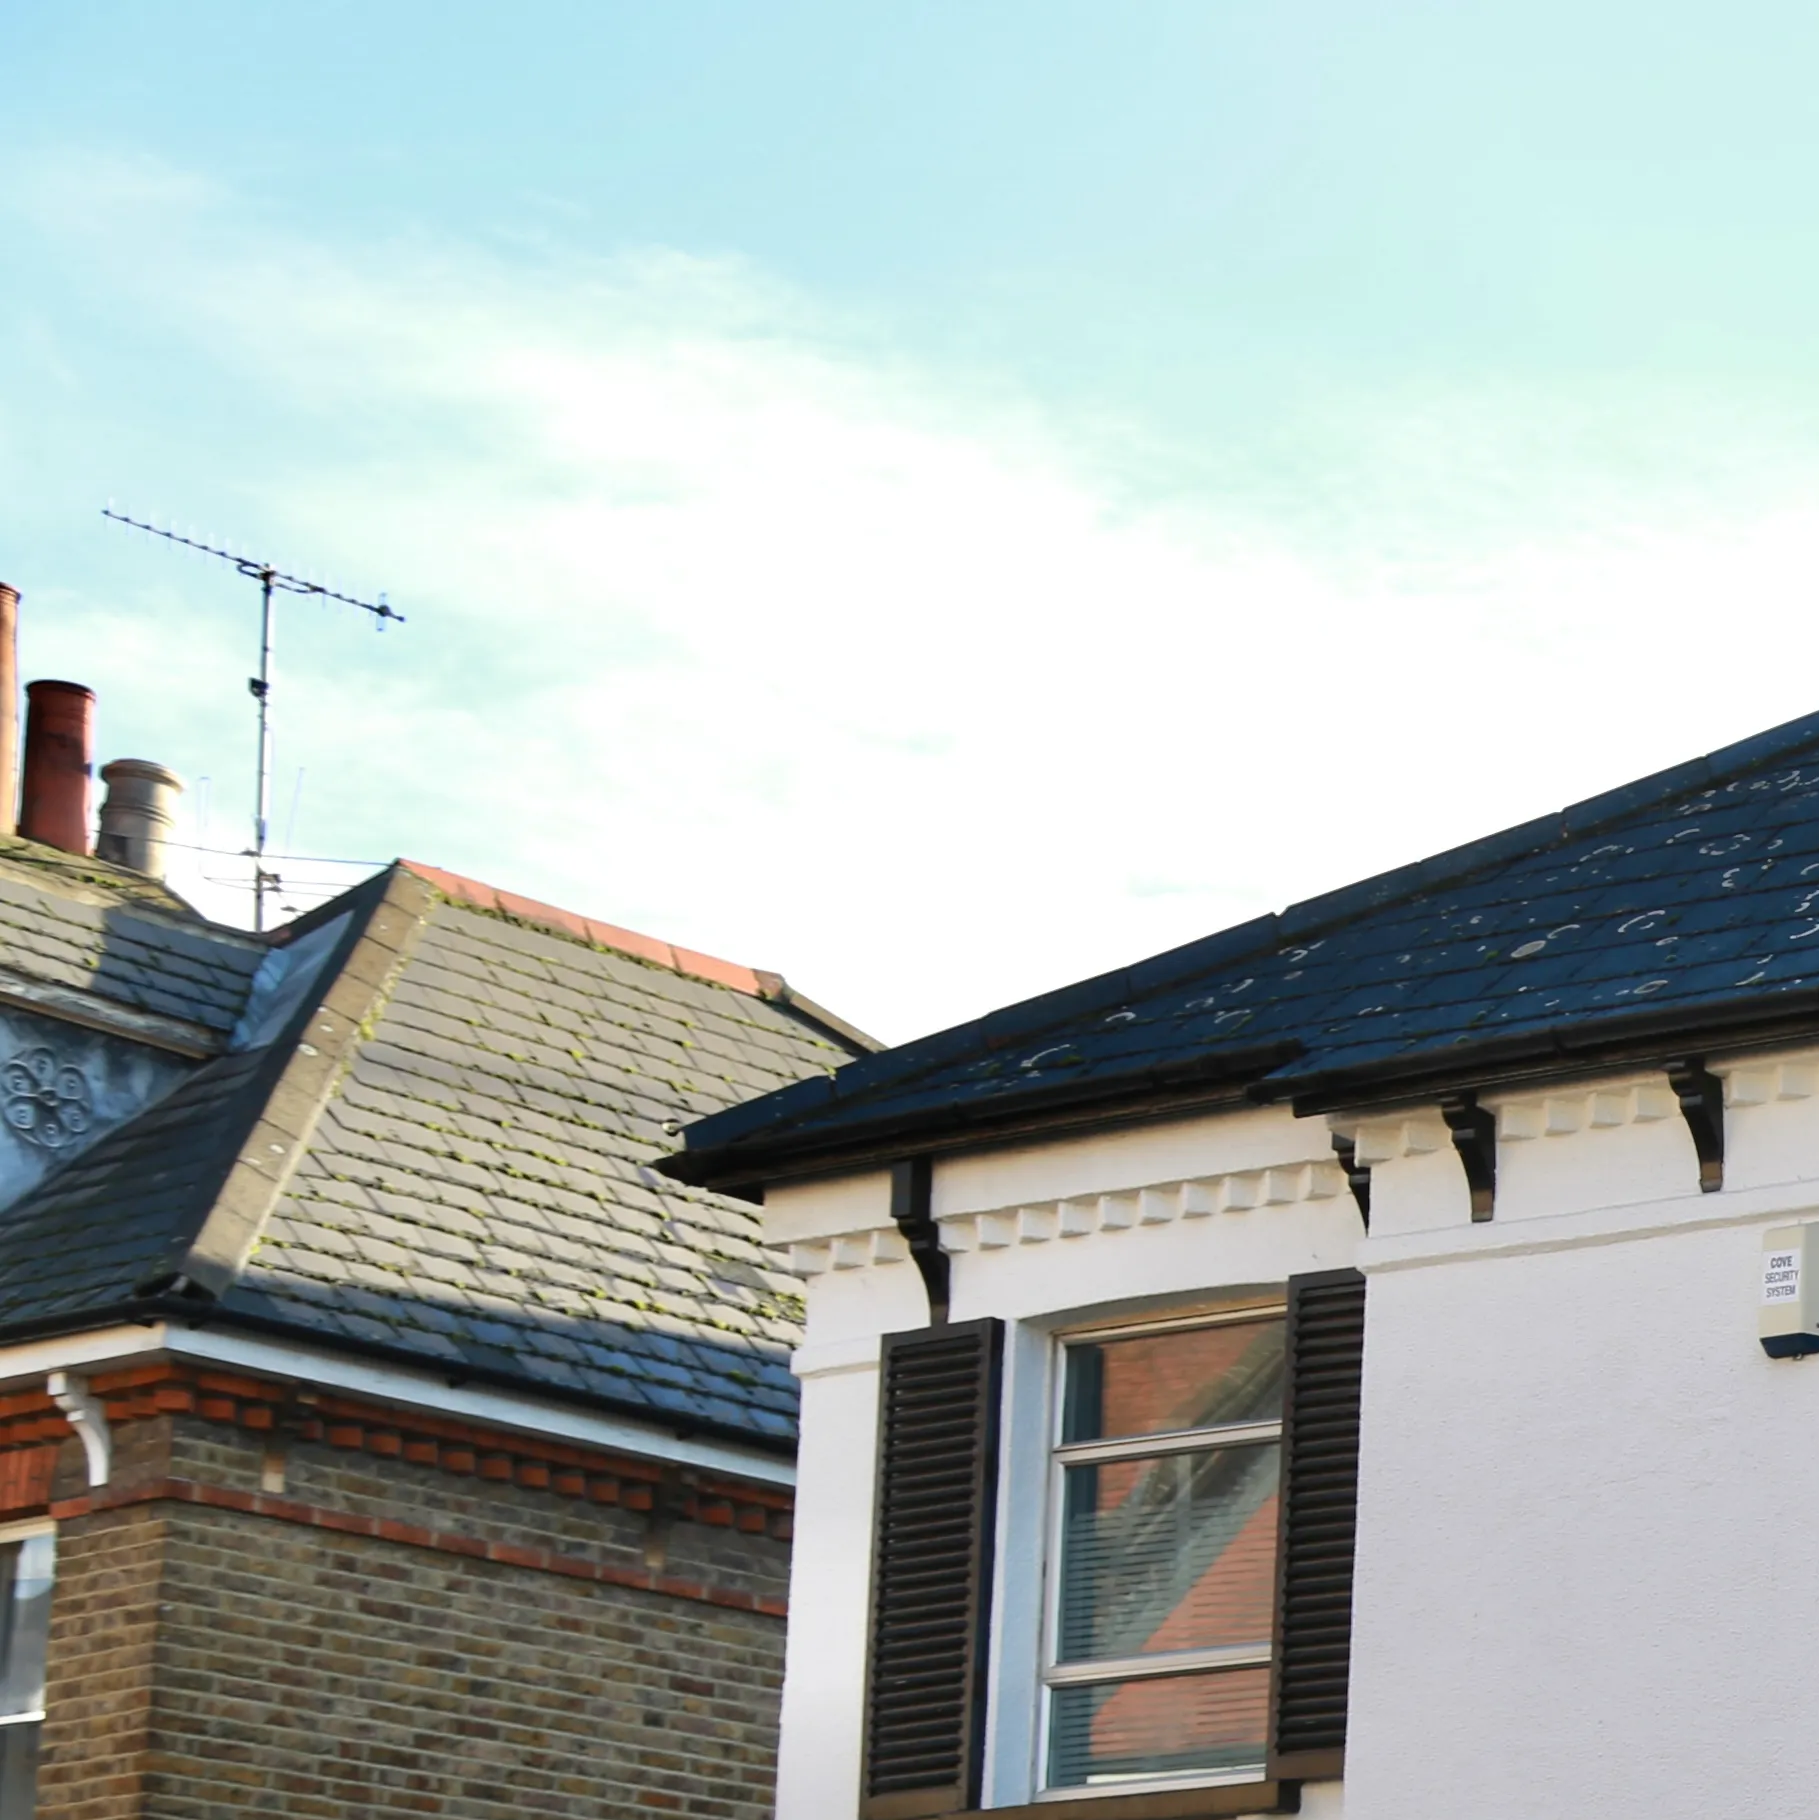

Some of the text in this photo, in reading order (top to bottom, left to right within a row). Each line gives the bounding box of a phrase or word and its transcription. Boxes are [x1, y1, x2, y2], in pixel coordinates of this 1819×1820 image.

[1770, 1255, 1793, 1269] COVE
[1764, 1269, 1800, 1284] SECURITY
[1766, 1285, 1796, 1298] SYSTEM
